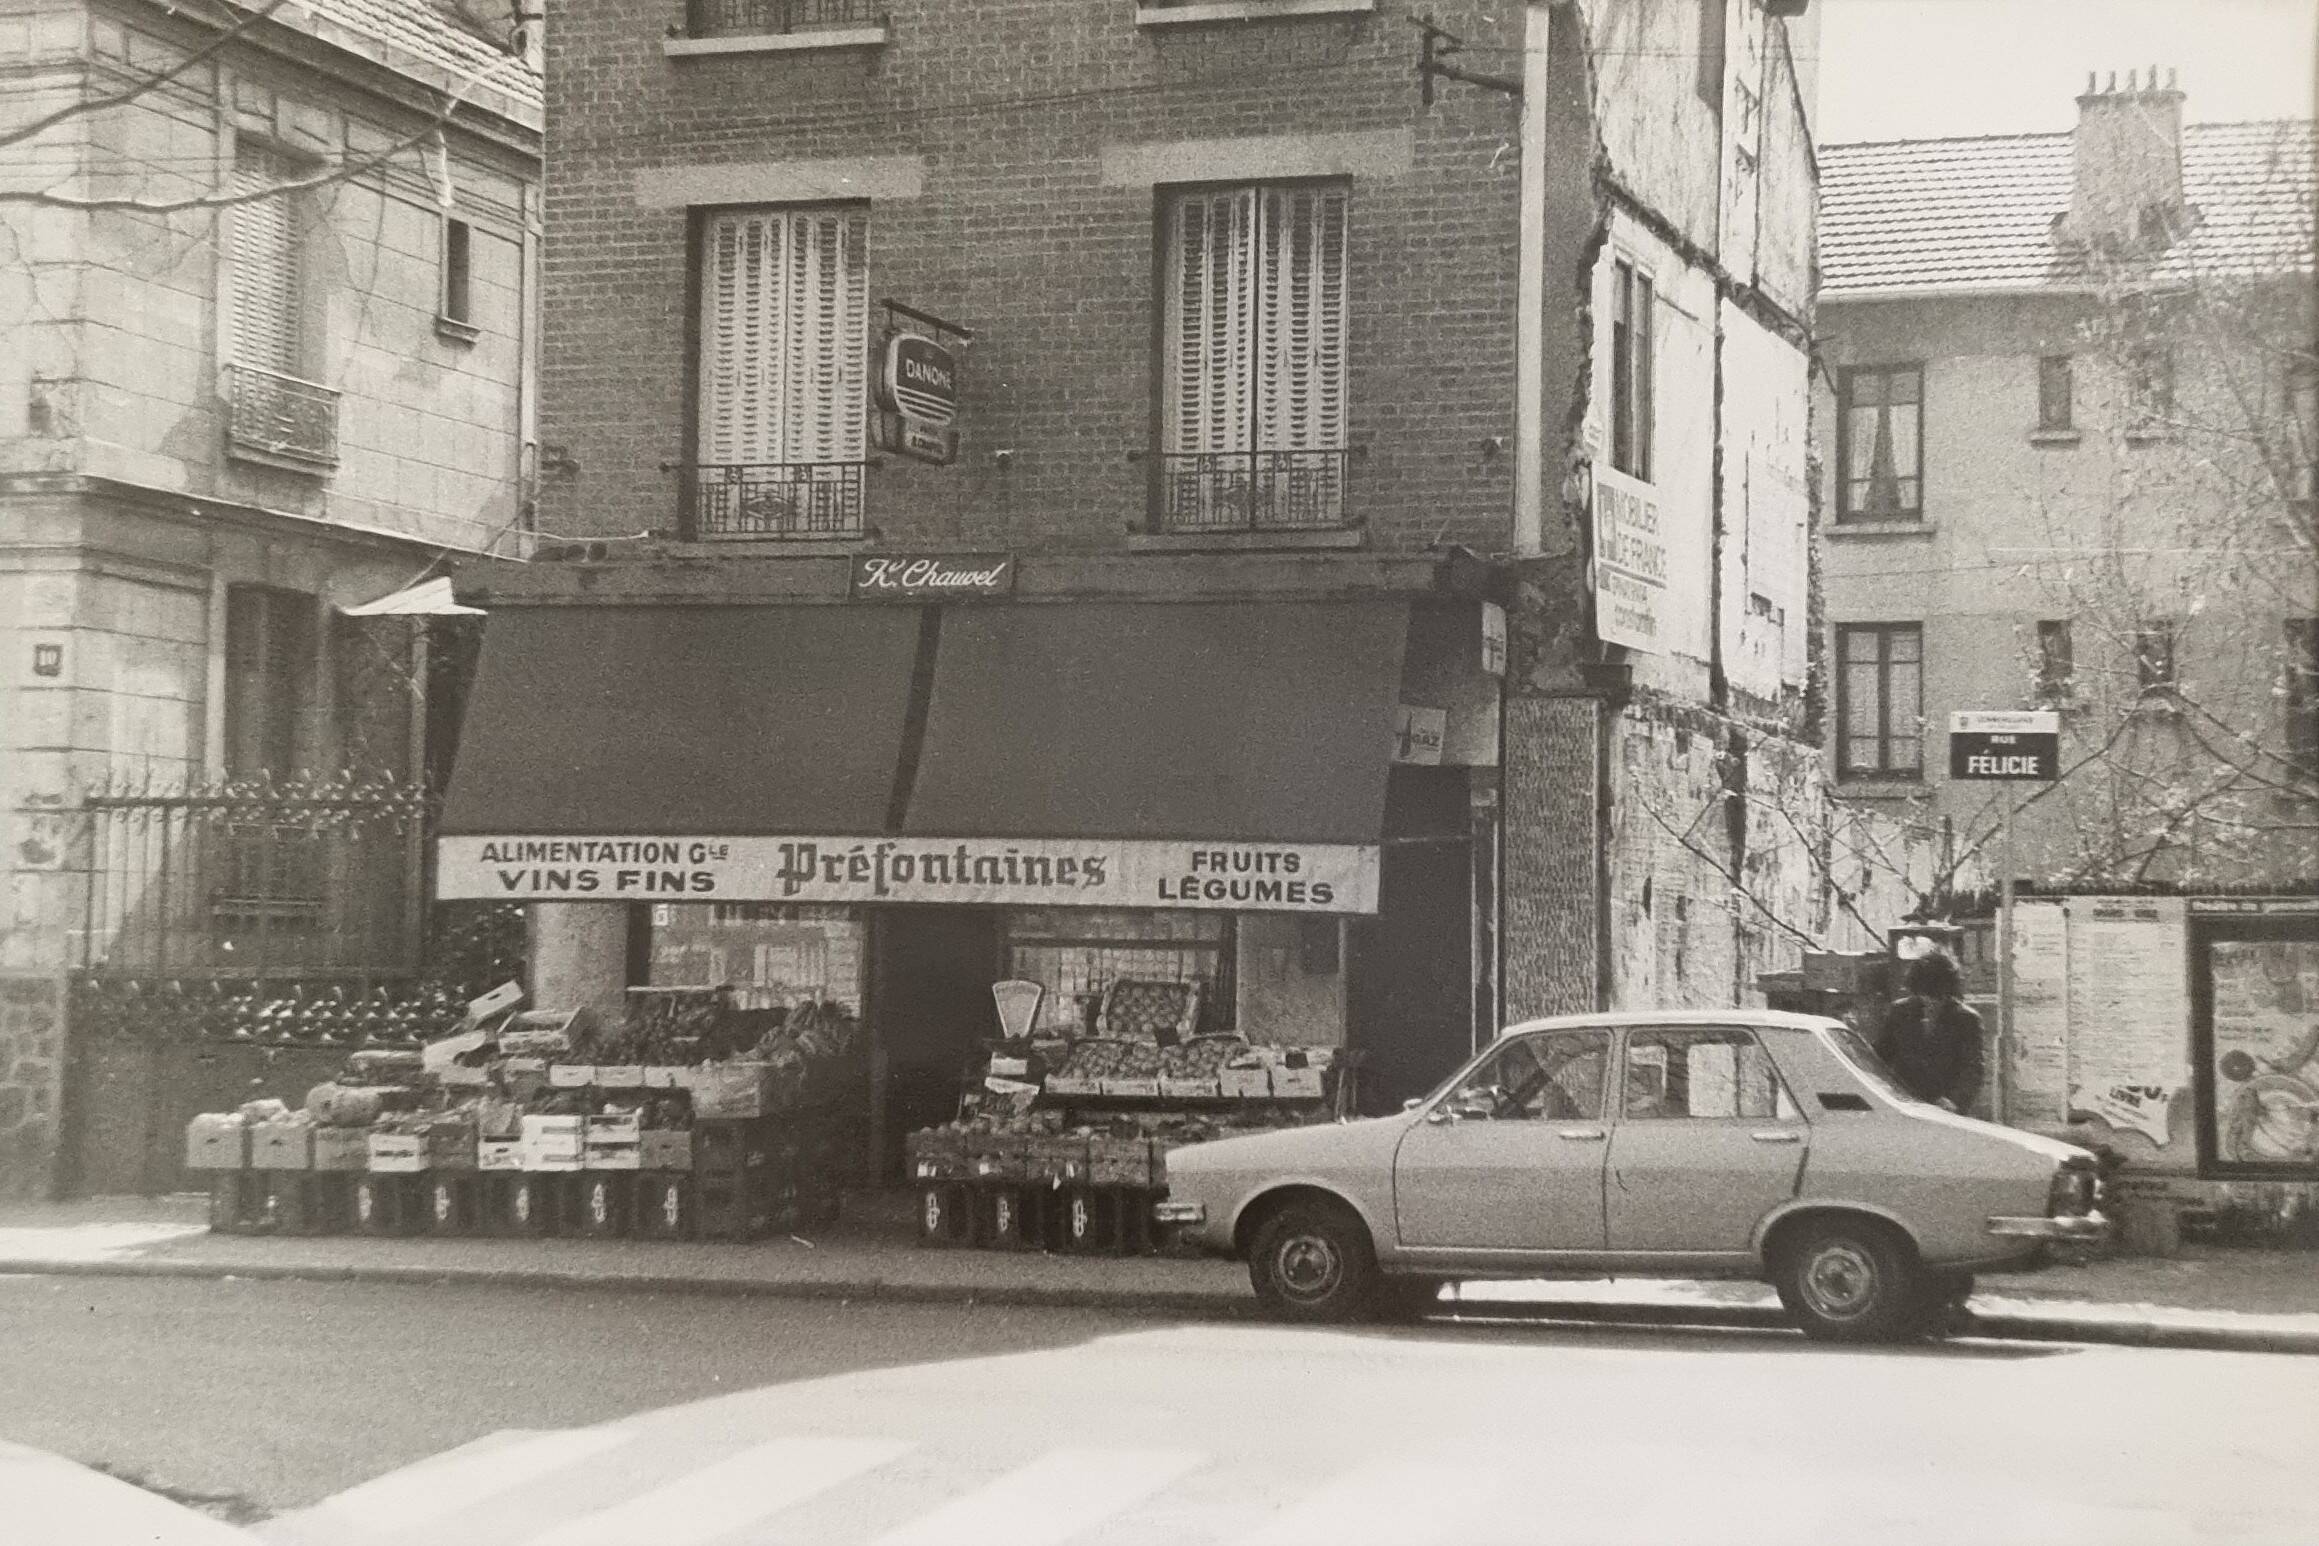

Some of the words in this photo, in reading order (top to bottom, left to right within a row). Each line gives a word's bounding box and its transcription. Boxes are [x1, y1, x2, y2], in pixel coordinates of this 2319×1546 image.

[902, 559, 1006, 587] Chauvel
[1967, 749, 2039, 775] FÉLICIE
[480, 841, 680, 864] ALIMENTATION
[1191, 851, 1301, 873] FRUITS
[498, 869, 600, 892] VINS
[616, 870, 716, 892] FINS
[775, 842, 1107, 896] Préfontaines
[1158, 875, 1335, 904] LÉGUMES
